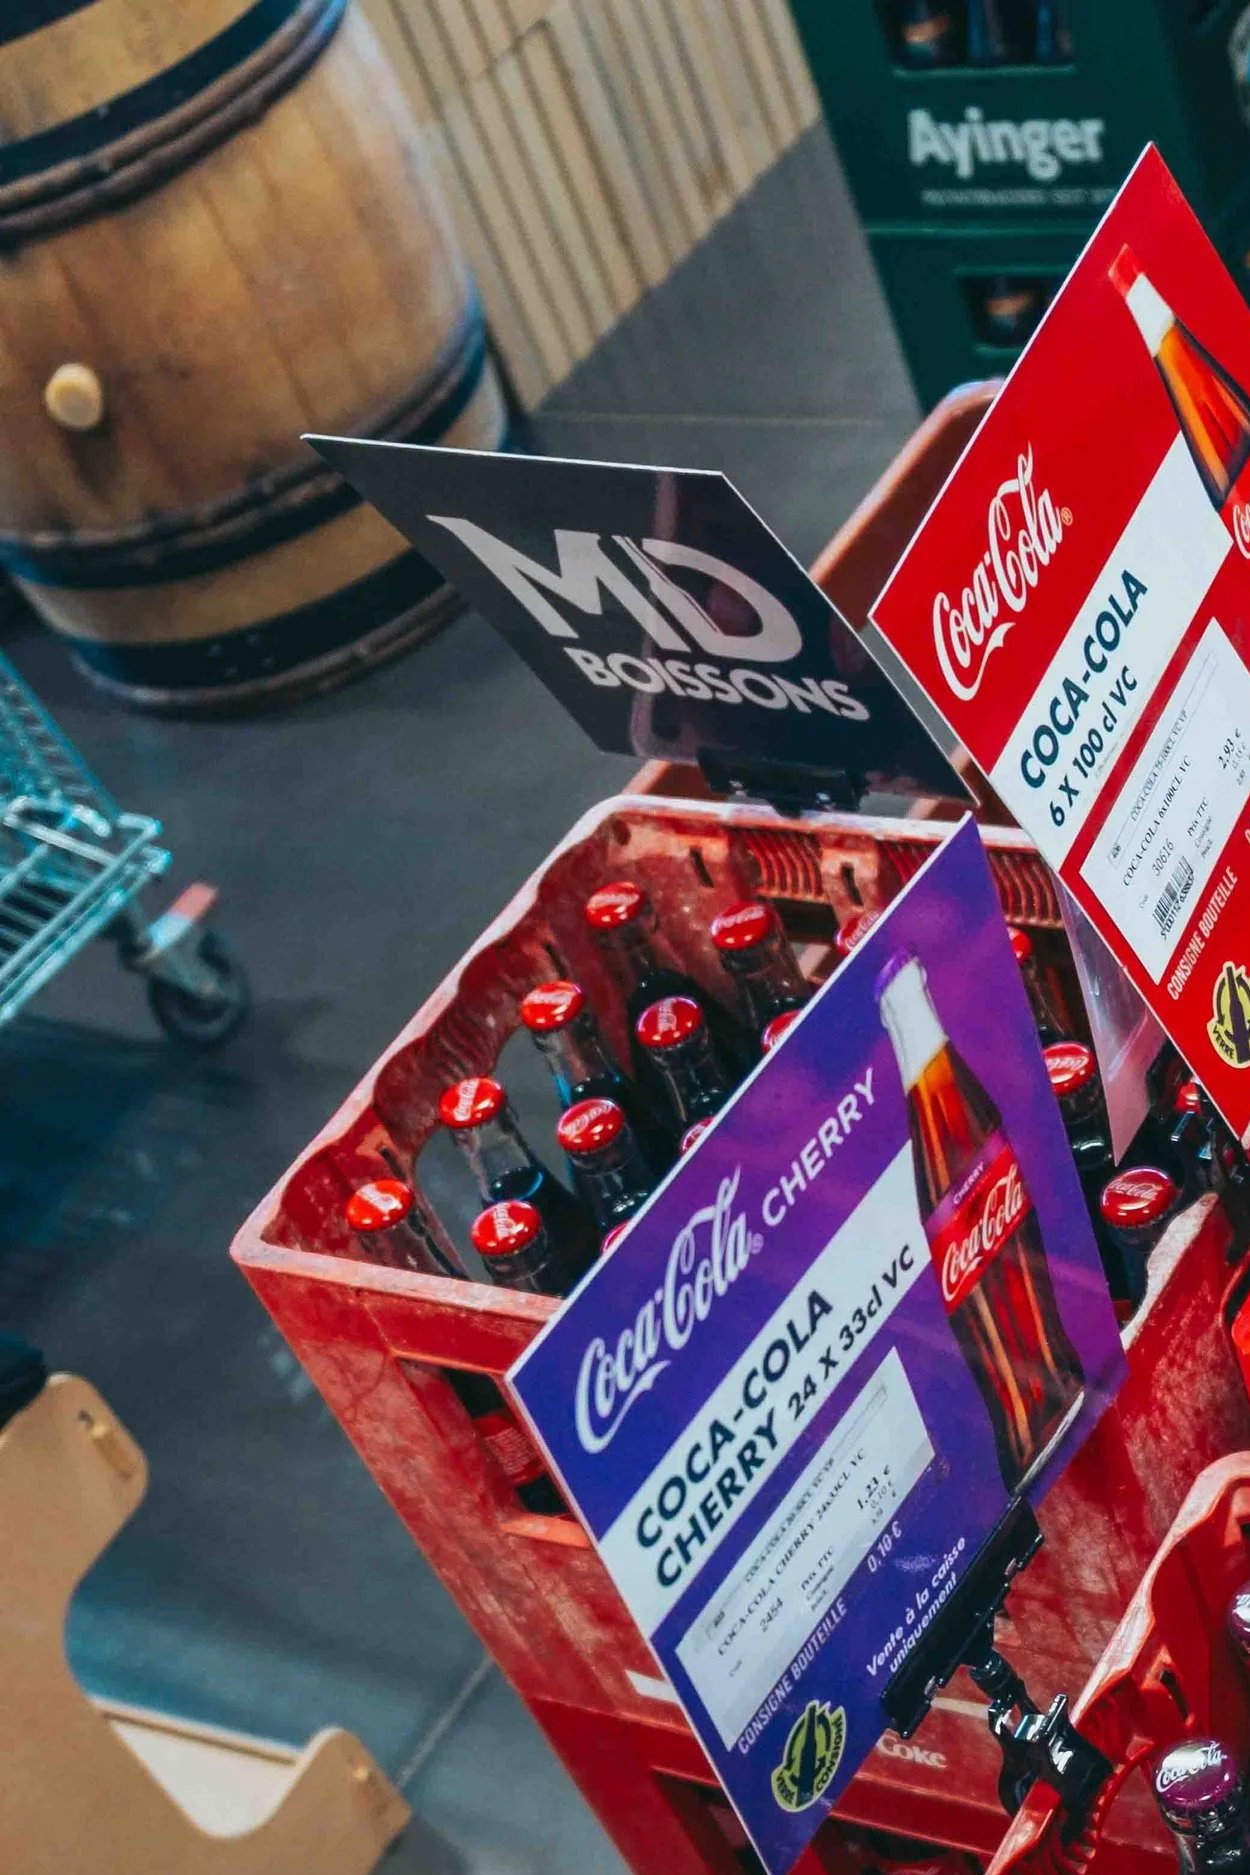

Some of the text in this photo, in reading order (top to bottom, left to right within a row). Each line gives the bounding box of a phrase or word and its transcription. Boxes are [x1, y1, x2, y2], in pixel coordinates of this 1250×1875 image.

[908, 106, 1104, 180] Ayinger
[933, 440, 1063, 701] Coca-Cola
[563, 646, 870, 721] BOISSONS
[1020, 569, 1148, 789] COCA-COLA
[1102, 701, 1118, 733] cl
[1109, 665, 1138, 708] VC
[1049, 801, 1066, 828] 6
[1072, 728, 1104, 779] 100
[1121, 816, 1160, 888] COCA-COLA
[1178, 754, 1192, 776] VC
[1167, 932, 1211, 1000] CONSIGNE
[1196, 865, 1239, 939] BOUTEILLE
[953, 1161, 985, 1205] CHERRY
[575, 1068, 876, 1454] Coca-Cola CHERRY
[636, 1289, 834, 1549] COCA-COLA
[656, 1409, 782, 1589] CHERRY
[787, 1380, 818, 1423] 24
[839, 1285, 884, 1350] 33cl
[881, 1245, 916, 1291] VC
[717, 1575, 775, 1657] COCA-COLA
[774, 1517, 816, 1576] CHERRY
[739, 1680, 794, 1755] CONSIGNE
[791, 1597, 848, 1681] BOUTEILLE
[867, 1538, 893, 1574] 0,10
[867, 1536, 966, 1677] Vente à la caisse
[889, 1574, 958, 1673] uniquement
